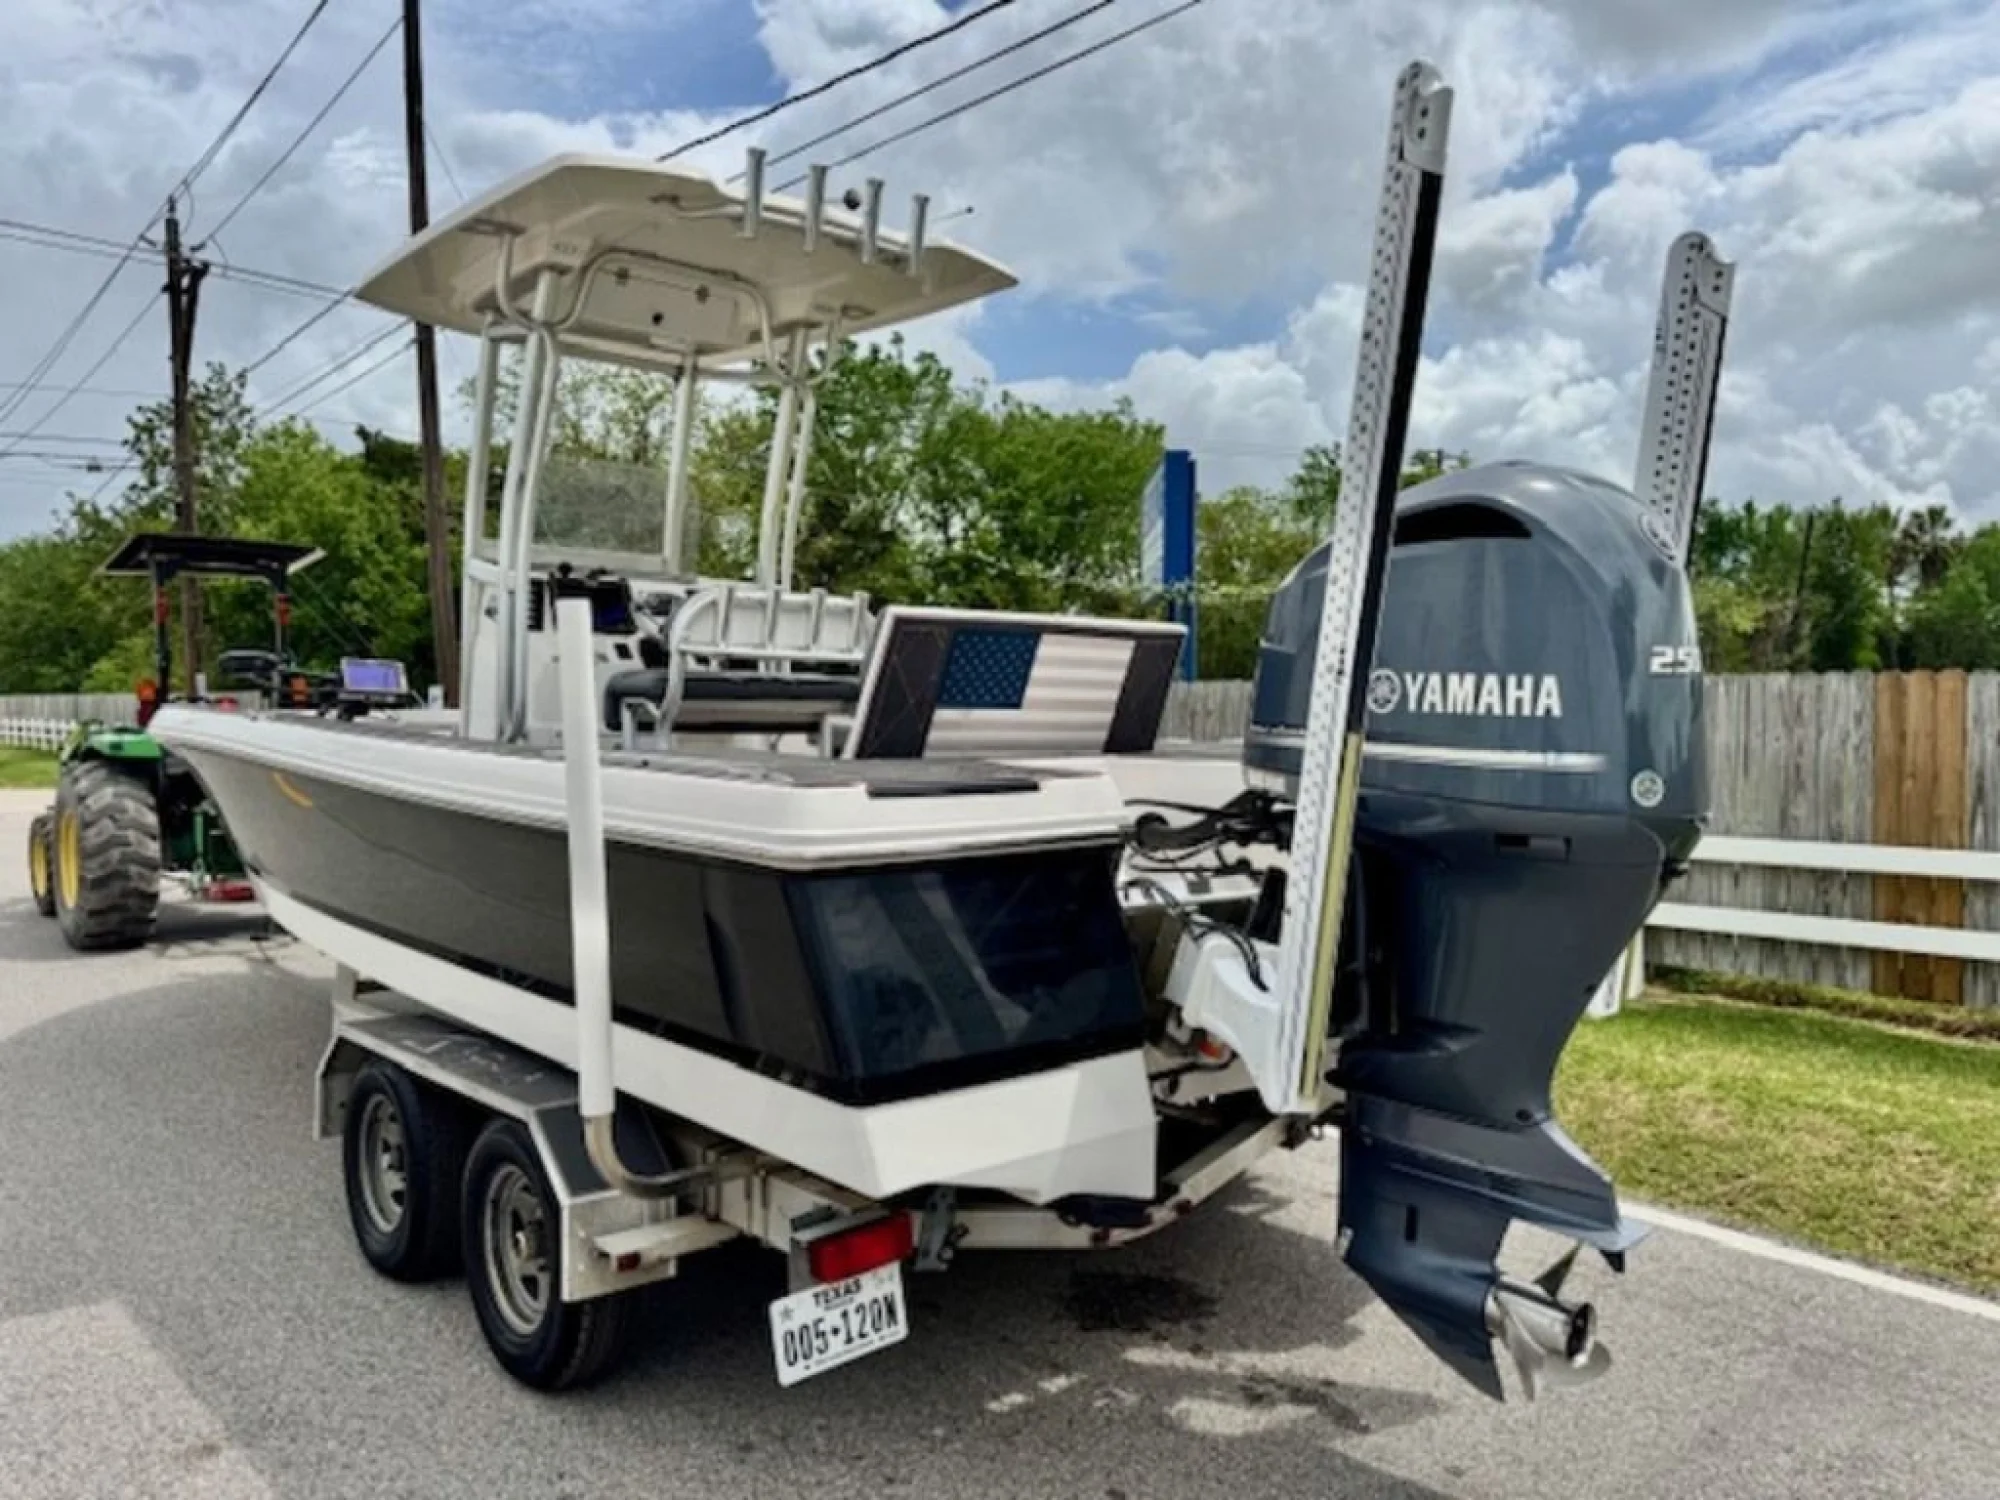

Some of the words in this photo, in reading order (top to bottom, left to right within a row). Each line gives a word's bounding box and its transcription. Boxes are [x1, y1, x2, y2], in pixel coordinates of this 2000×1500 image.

[1650, 645, 1701, 673] 25
[1404, 672, 1562, 718] YAMAHA
[812, 1278, 861, 1307] TEXAS
